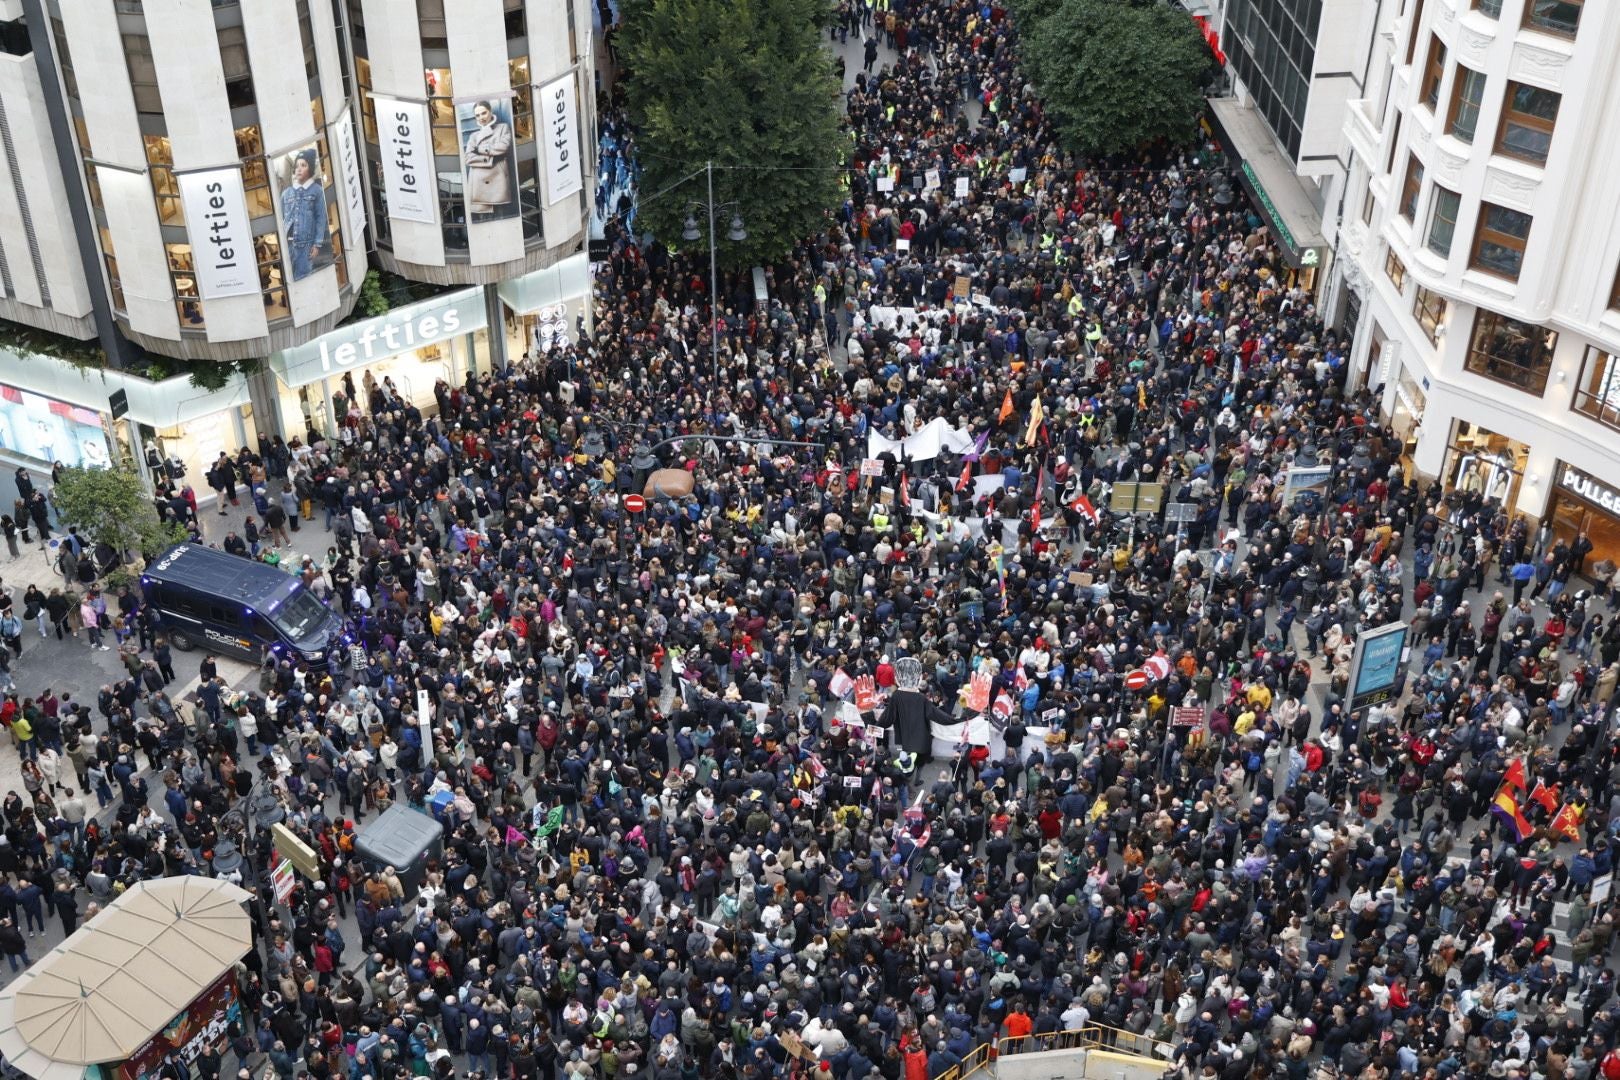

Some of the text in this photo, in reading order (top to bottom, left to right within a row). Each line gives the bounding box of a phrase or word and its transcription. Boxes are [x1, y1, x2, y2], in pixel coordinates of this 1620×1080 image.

[393, 112, 417, 193] lefties
[553, 88, 569, 172] lefties
[205, 182, 236, 269] lefties
[319, 307, 460, 371] lefties
[1076, 503, 1096, 527] CNT
[205, 628, 240, 644] POLICIA
[993, 707, 1008, 722] CGT
